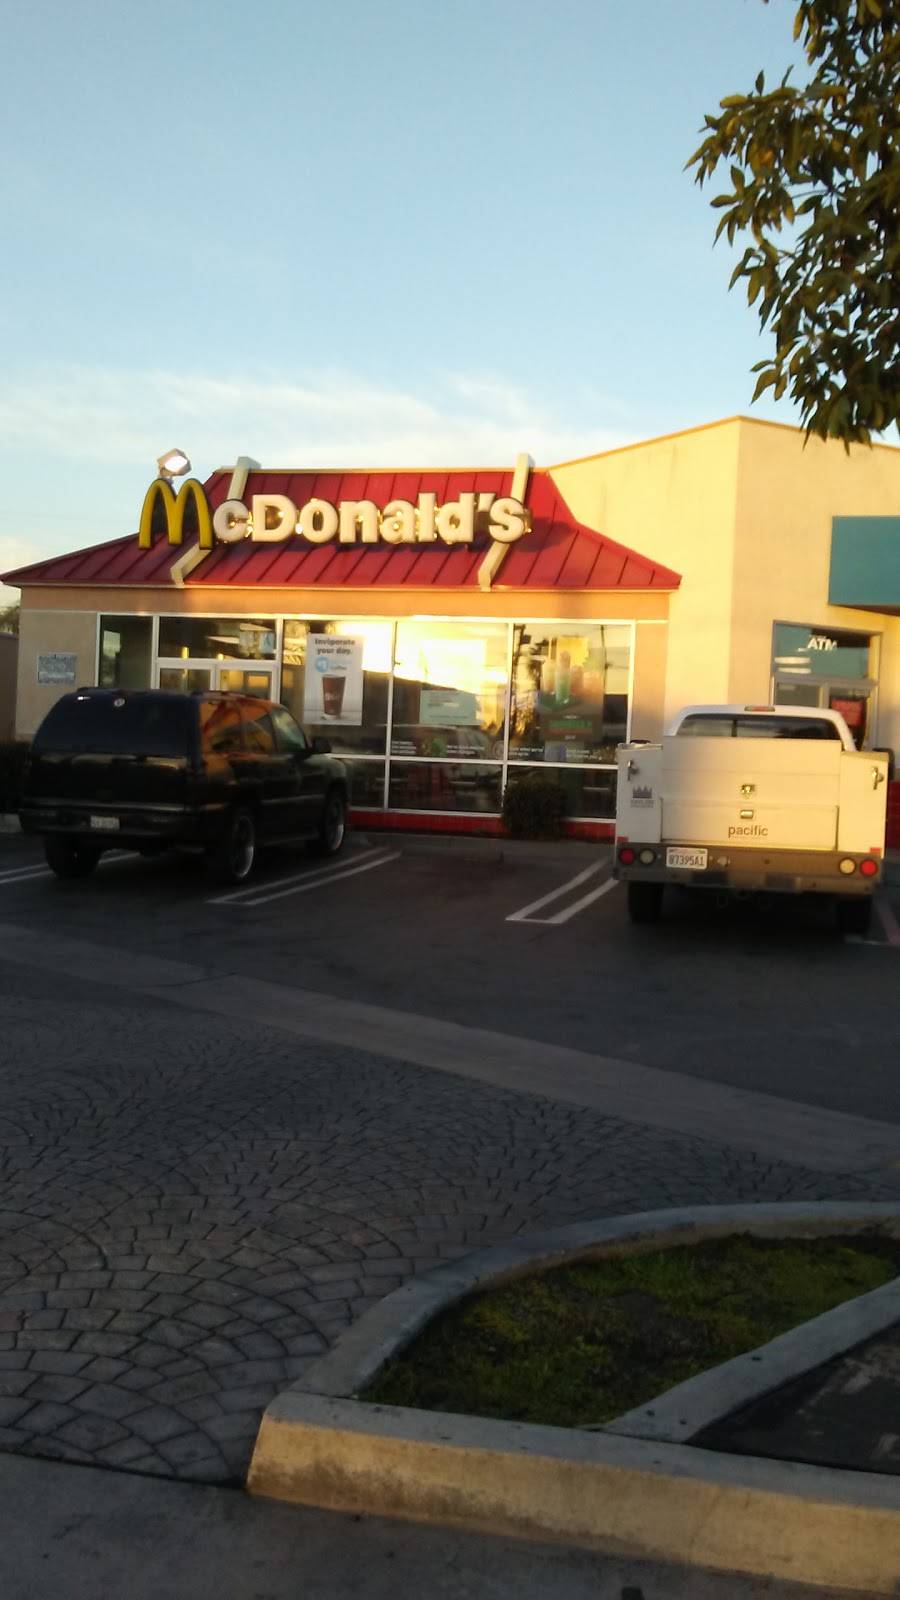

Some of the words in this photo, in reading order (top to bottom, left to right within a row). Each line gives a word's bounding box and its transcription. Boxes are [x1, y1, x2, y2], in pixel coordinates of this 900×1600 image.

[138, 477, 531, 549] McDonald's
[807, 637, 838, 650] ATM
[728, 825, 769, 838] pacific
